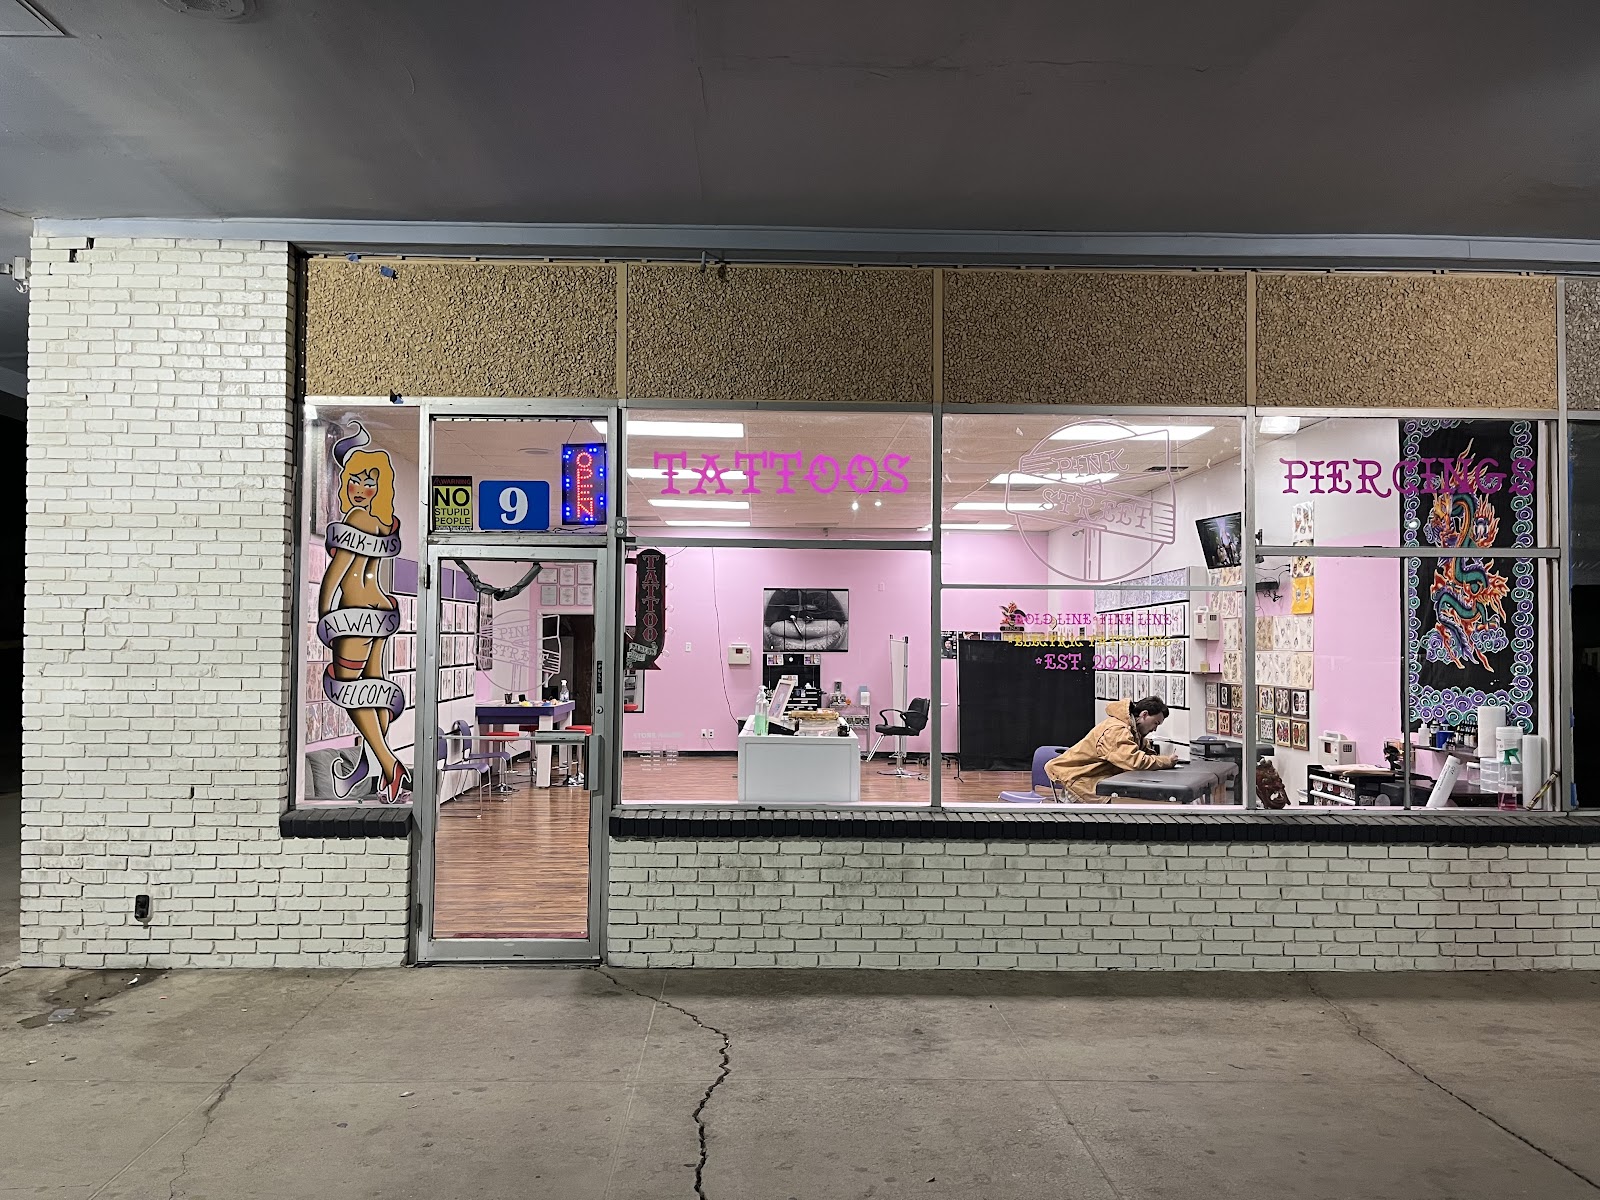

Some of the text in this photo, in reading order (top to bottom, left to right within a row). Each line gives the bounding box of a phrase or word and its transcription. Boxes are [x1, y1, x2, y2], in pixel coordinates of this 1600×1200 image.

[653, 450, 911, 495] TATTOOS
[1051, 448, 1129, 481] PINK
[1279, 457, 1536, 498] PIERCINGS
[434, 487, 470, 507] NO
[576, 451, 593, 518] OPEN
[434, 507, 470, 516] STUPID
[498, 487, 529, 525] 9
[1039, 487, 1151, 529] STREET
[435, 517, 471, 525] PEOPLE
[331, 525, 400, 553] WALK-INS
[641, 554, 660, 642] TATTOO
[323, 613, 397, 639] ALWAYS
[1014, 613, 1172, 625] BOLD LINE FINE LINE
[1014, 634, 1172, 649] ELECTRIC TATTOOING
[1044, 653, 1142, 670] EST. 2022
[329, 681, 400, 707] WELCOME
